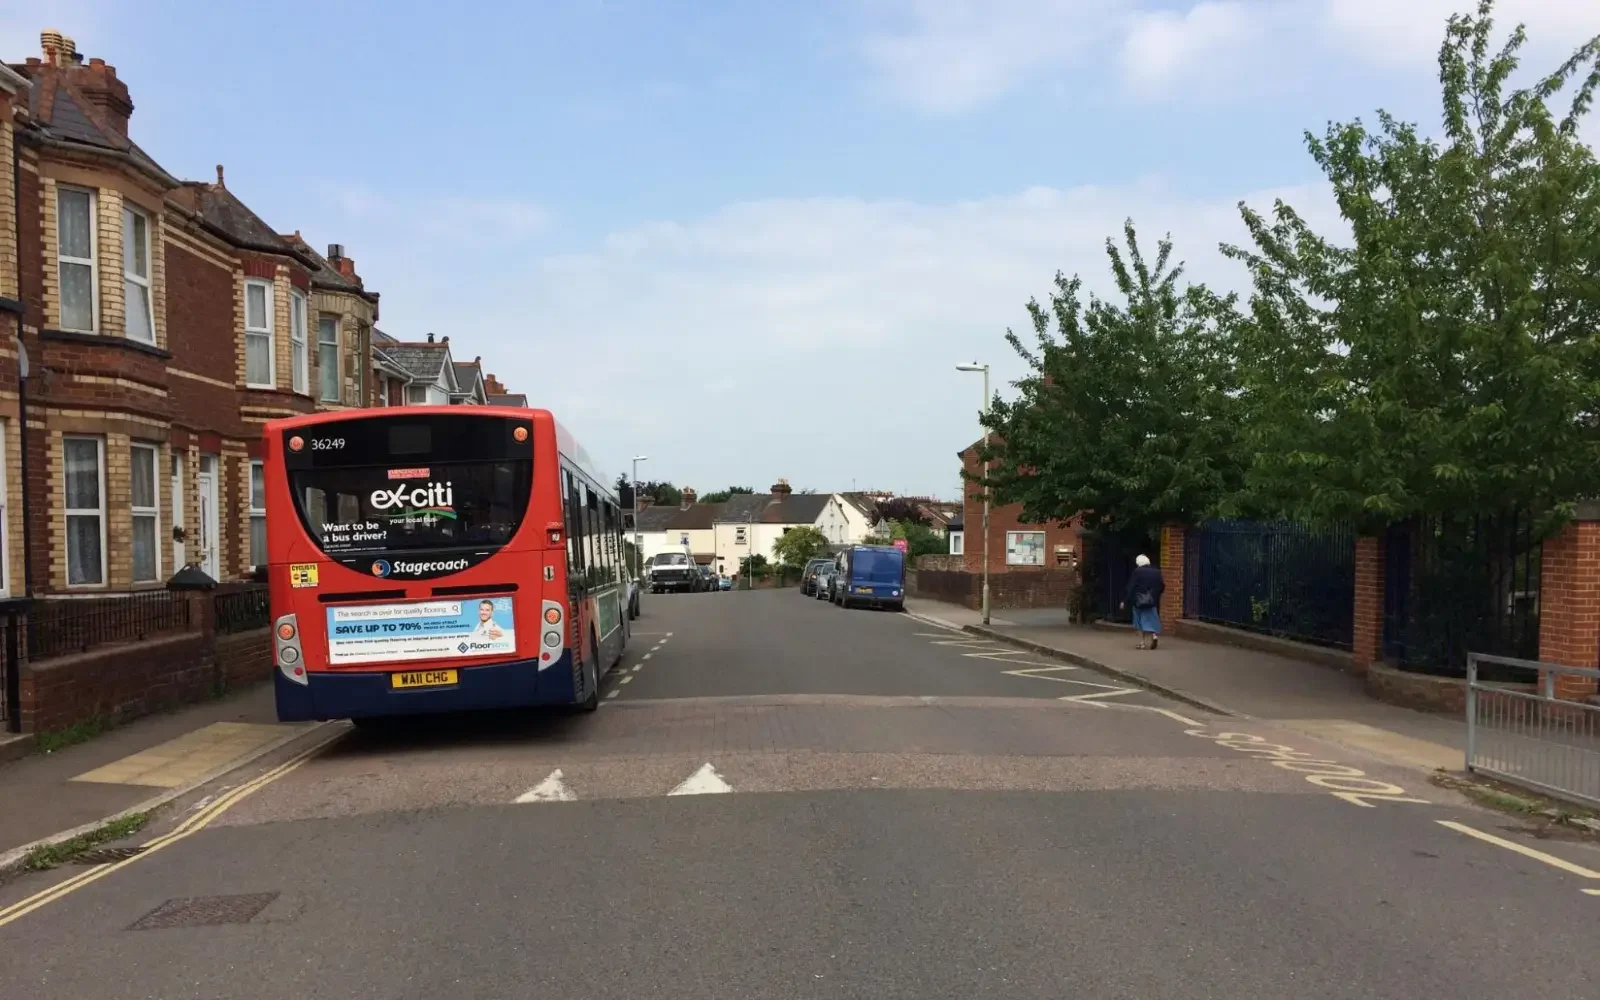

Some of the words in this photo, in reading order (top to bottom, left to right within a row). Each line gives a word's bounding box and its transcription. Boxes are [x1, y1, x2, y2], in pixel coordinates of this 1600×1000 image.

[311, 438, 345, 450] 36249
[370, 481, 453, 510] ex-citi
[322, 523, 350, 532] Want
[352, 522, 364, 530] to
[366, 521, 379, 530] be
[332, 533, 350, 542] bus
[352, 530, 387, 542] driver?
[393, 558, 468, 575] Stagecoach
[404, 608, 422, 616] quality
[336, 625, 363, 634] SAVE
[366, 624, 380, 632] UP
[382, 624, 396, 632] TO
[398, 622, 422, 631] 70%
[401, 672, 422, 684] WA11
[426, 672, 448, 683] CHG
